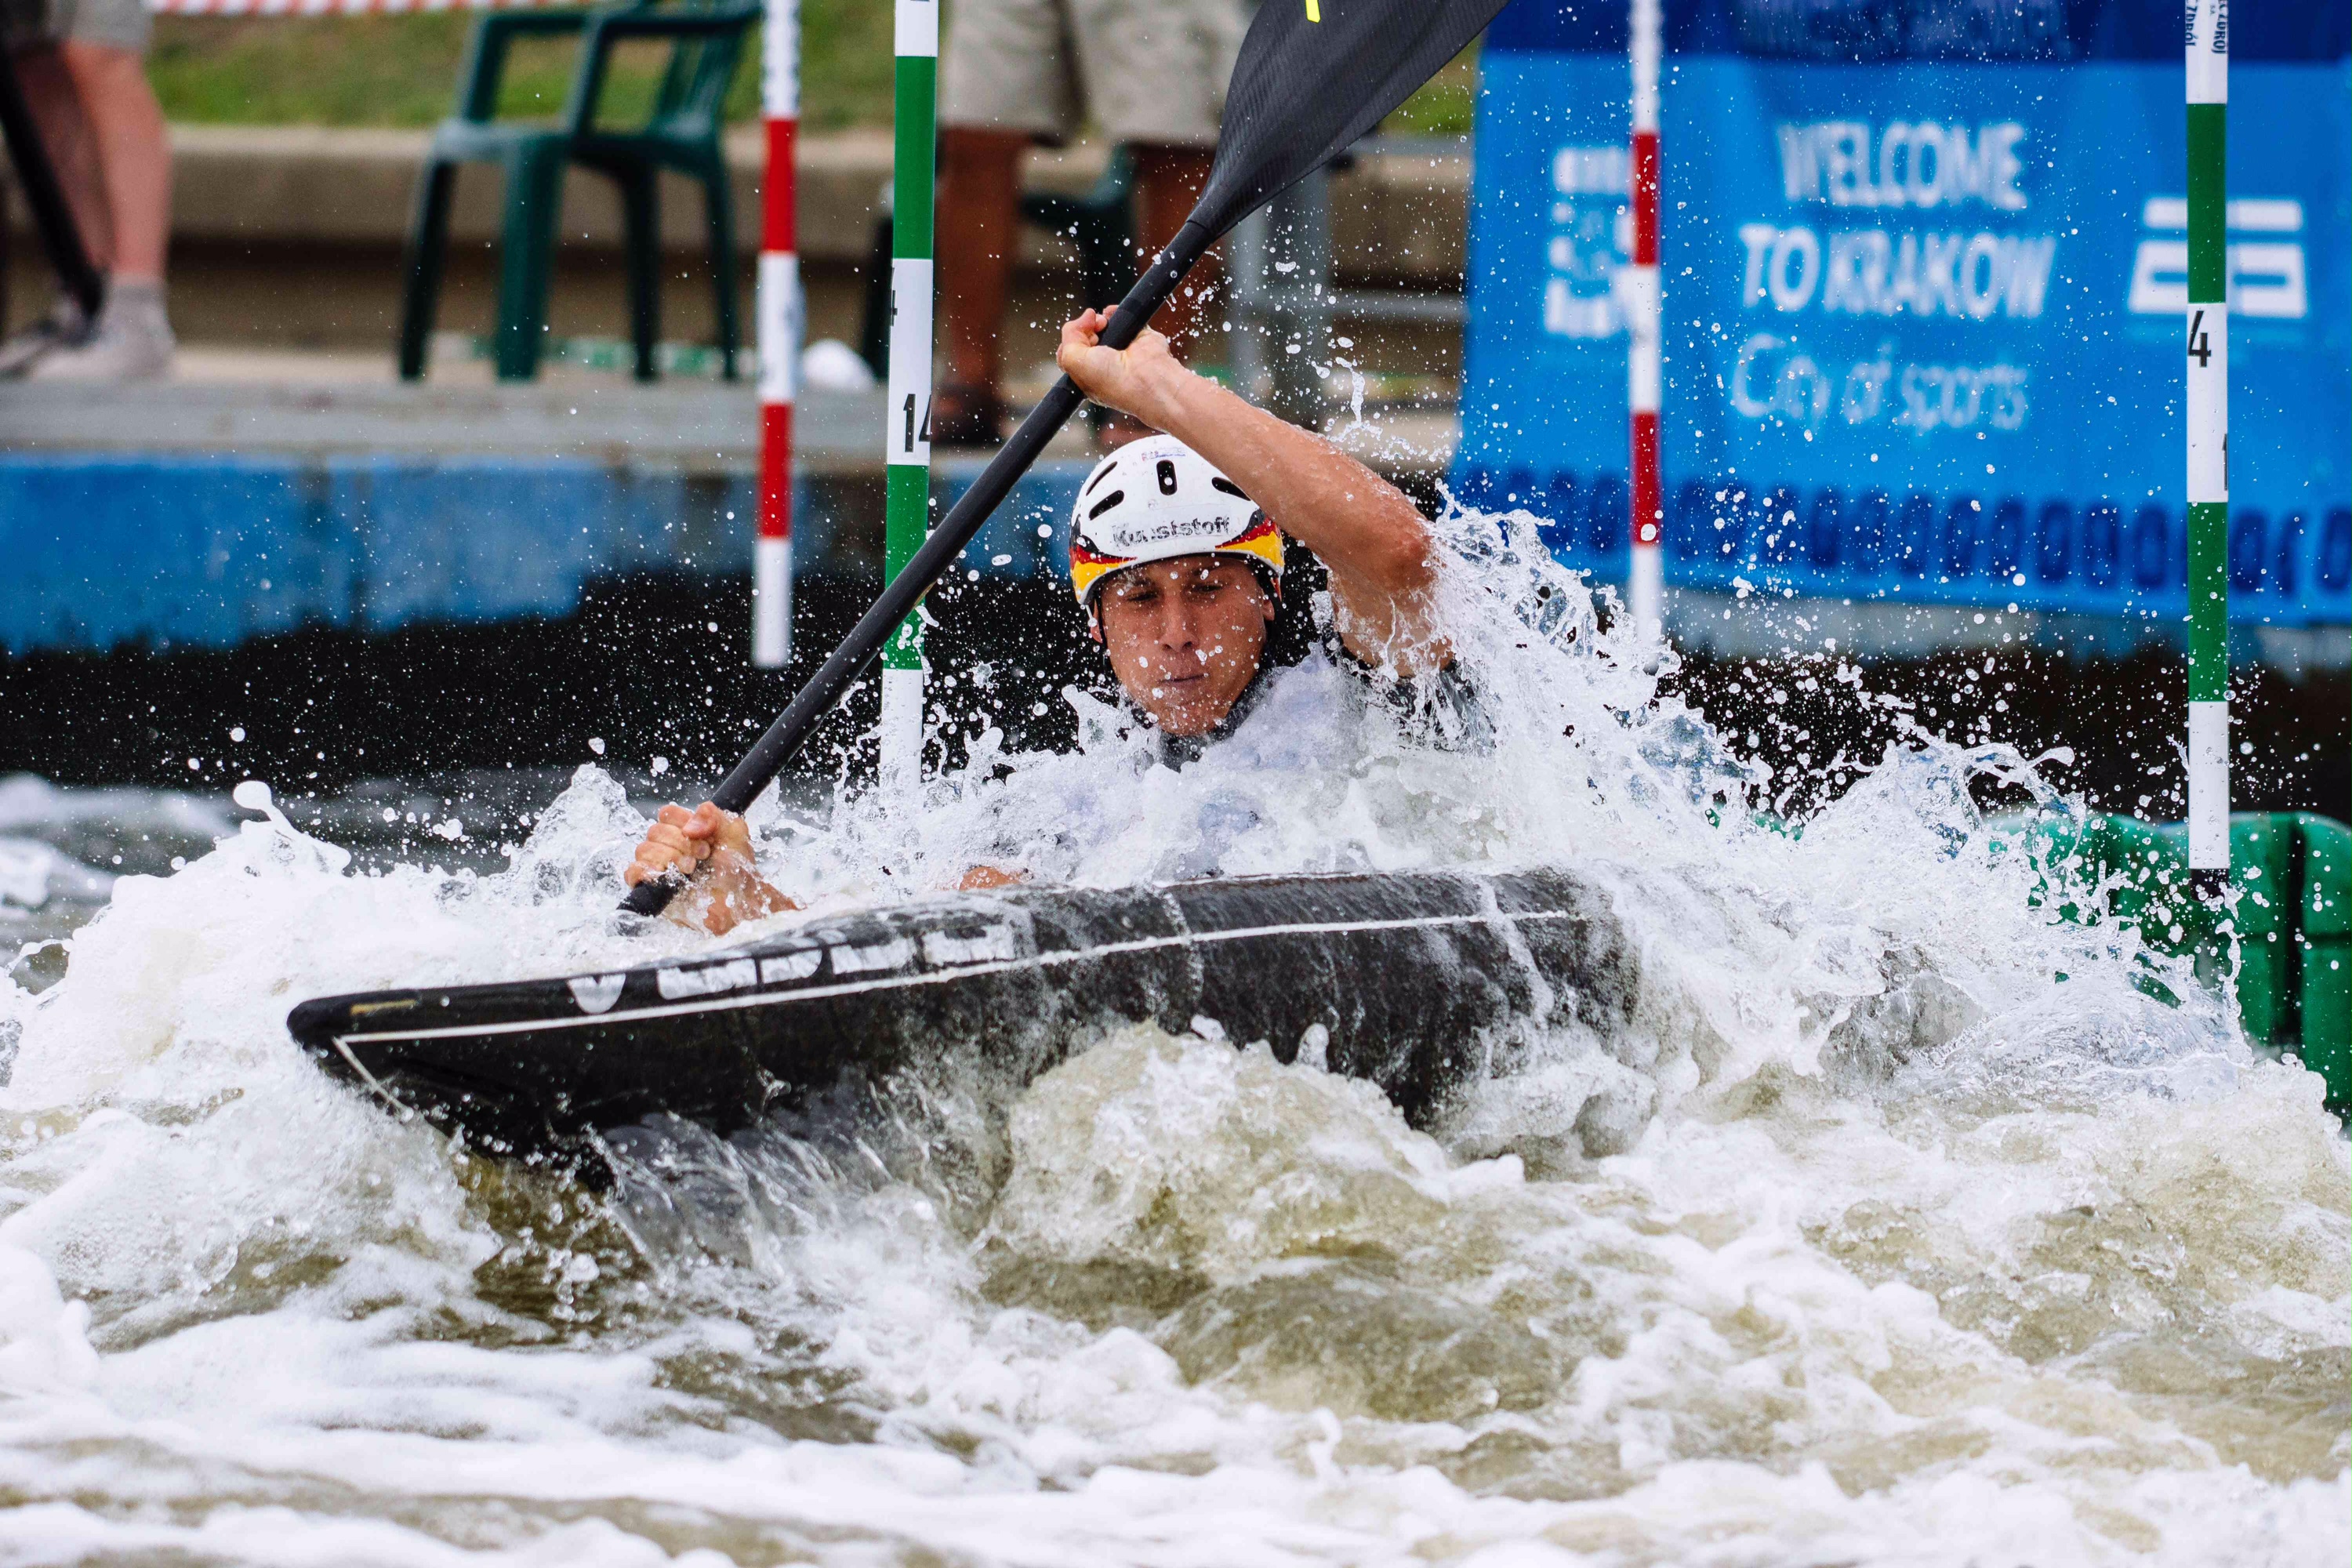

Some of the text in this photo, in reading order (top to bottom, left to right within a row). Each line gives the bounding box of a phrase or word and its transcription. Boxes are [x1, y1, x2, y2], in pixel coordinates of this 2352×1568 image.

[1777, 120, 2029, 211] WELCOME
[1739, 222, 1820, 314] TO
[1732, 332, 2029, 437] City of sports
